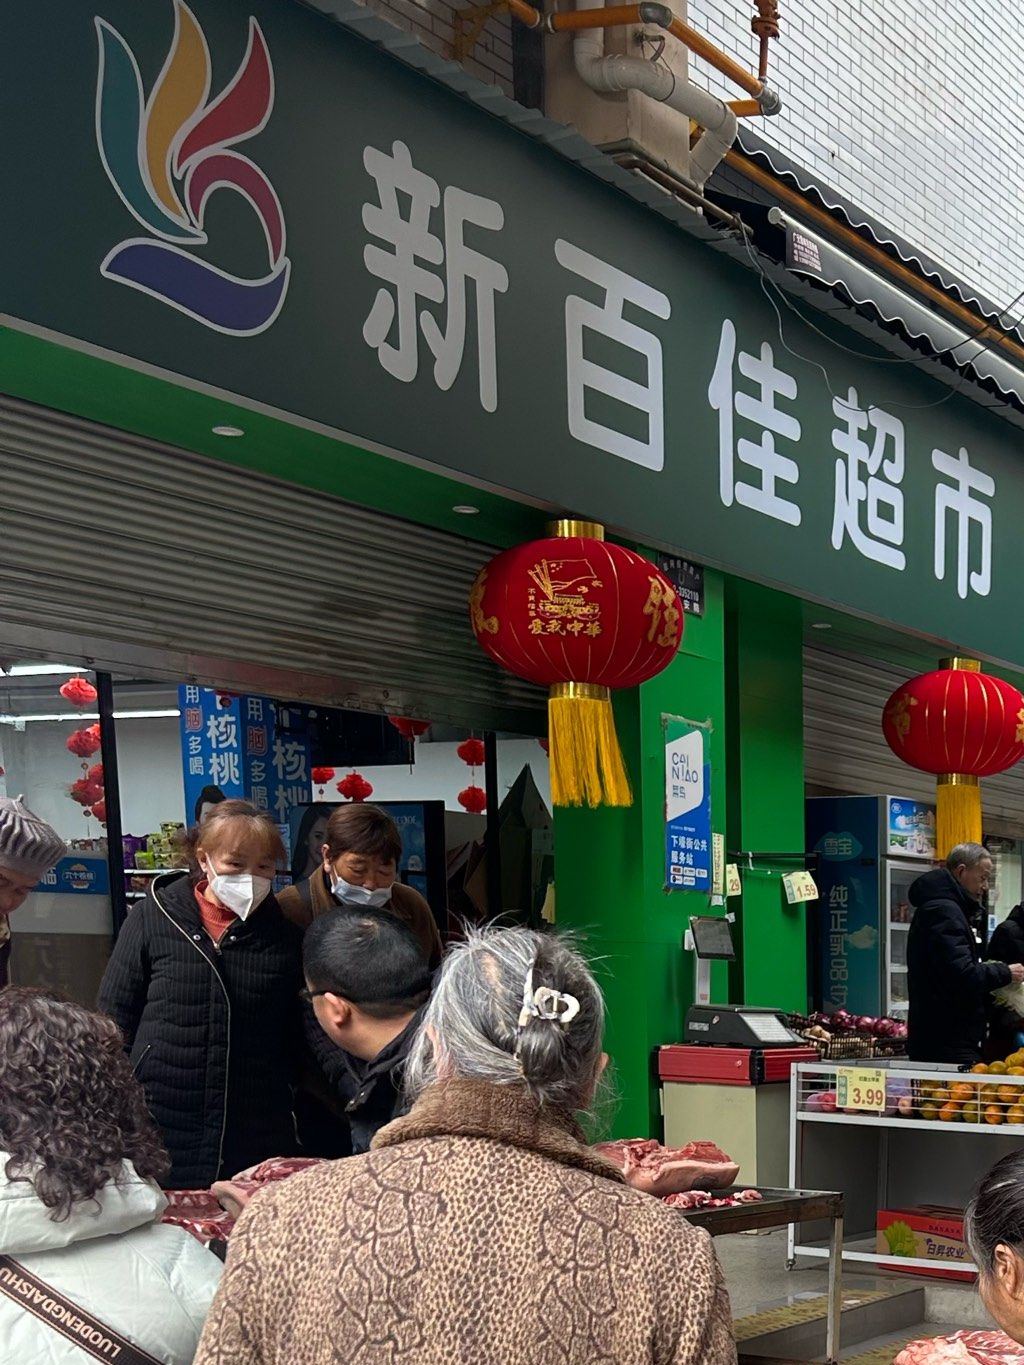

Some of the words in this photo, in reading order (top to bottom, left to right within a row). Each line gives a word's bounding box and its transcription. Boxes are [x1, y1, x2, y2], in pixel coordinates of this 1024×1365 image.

[363, 140, 996, 599] 新百佳超市
[852, 1087, 884, 1106] 3.99
[927, 1242, 965, 1259] 日昇农业
[0, 1267, 123, 1359] LUODENGDAISHU
